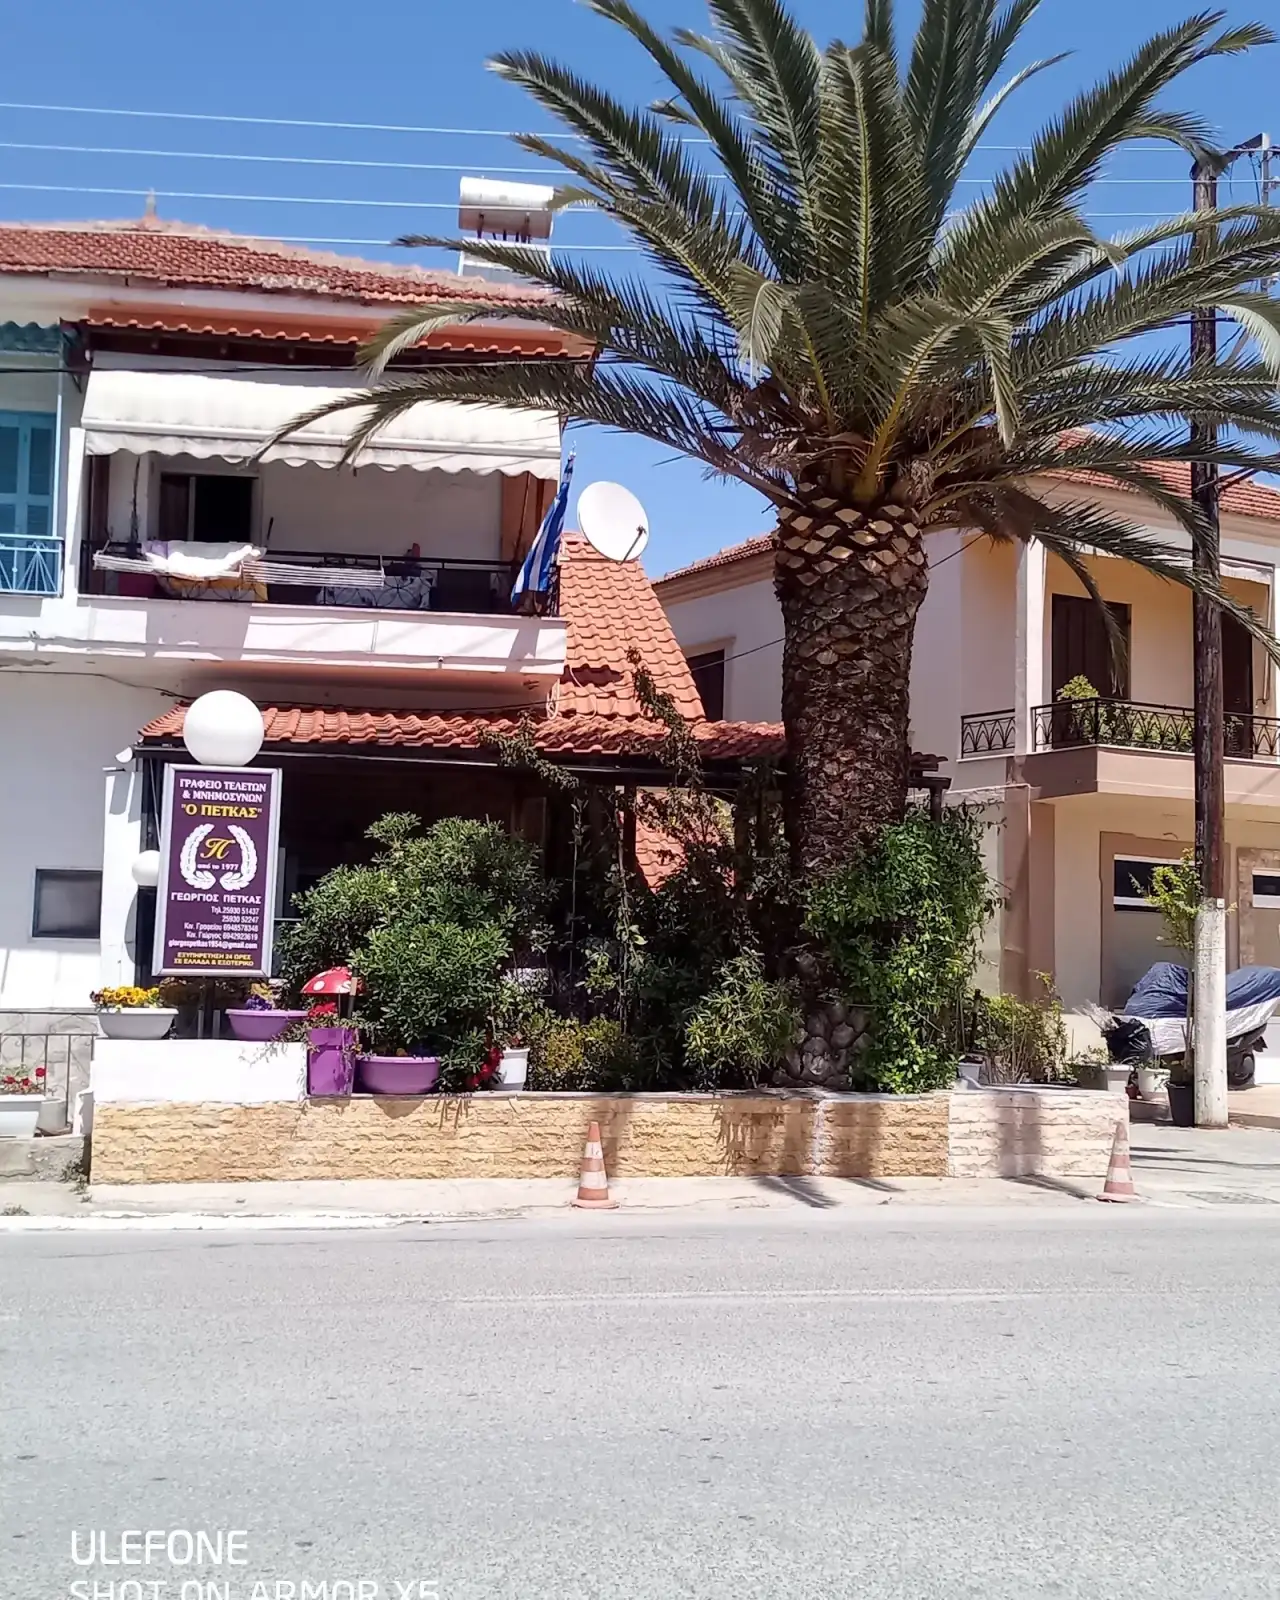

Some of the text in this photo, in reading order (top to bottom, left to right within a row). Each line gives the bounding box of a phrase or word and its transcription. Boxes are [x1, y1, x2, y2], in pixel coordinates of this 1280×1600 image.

[179, 778, 267, 792] ΓΡΑΦΕΙΟ ΤΕΛΕΤΩΝ
[182, 790, 263, 803] & ΜΝΗΜΟΣΥΝΩΝ
[221, 863, 239, 871] 1977
[171, 892, 261, 904] ΓΕΩΡΓΙΟΣ ΠΕΤΚΑΣ
[241, 907, 260, 915] 51437
